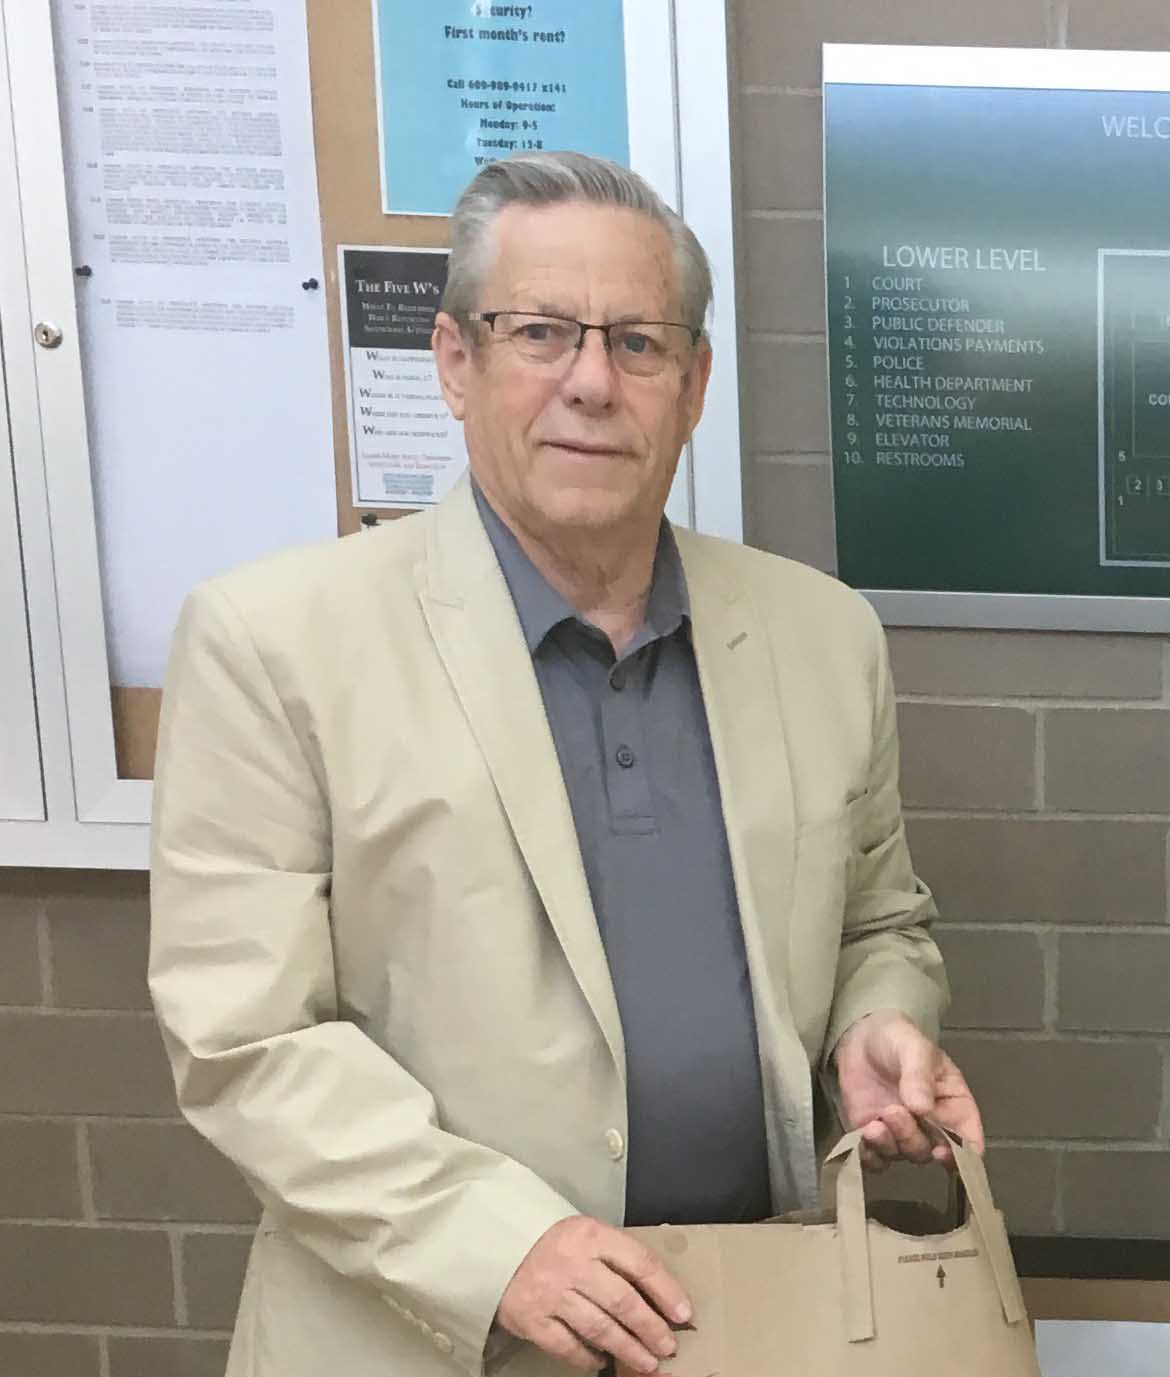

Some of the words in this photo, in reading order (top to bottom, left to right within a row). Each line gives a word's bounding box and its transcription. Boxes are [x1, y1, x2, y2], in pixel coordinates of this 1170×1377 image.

[445, 26, 474, 40] First
[479, 28, 528, 41] month's
[533, 30, 565, 42] rent?
[883, 246, 968, 268] LOWER
[976, 248, 1046, 271] LEVEL
[872, 276, 922, 290] COURT
[872, 296, 969, 312] PROSECUTOR
[872, 316, 924, 330] PUBLIC
[928, 318, 1005, 333] DEFENDER
[874, 336, 962, 350] VIOLATIONS
[966, 338, 1044, 354] PAYMENTS
[873, 355, 924, 370] POLICE
[874, 376, 930, 389] HEALTH
[935, 377, 1033, 392] DEPARTMENT
[876, 394, 976, 410] TECHNOLOGY
[876, 414, 949, 428] VETERANS
[954, 416, 1032, 430] MEMORIAL
[876, 433, 949, 447] ELEVATOR
[876, 452, 964, 467] RESTROOMS
